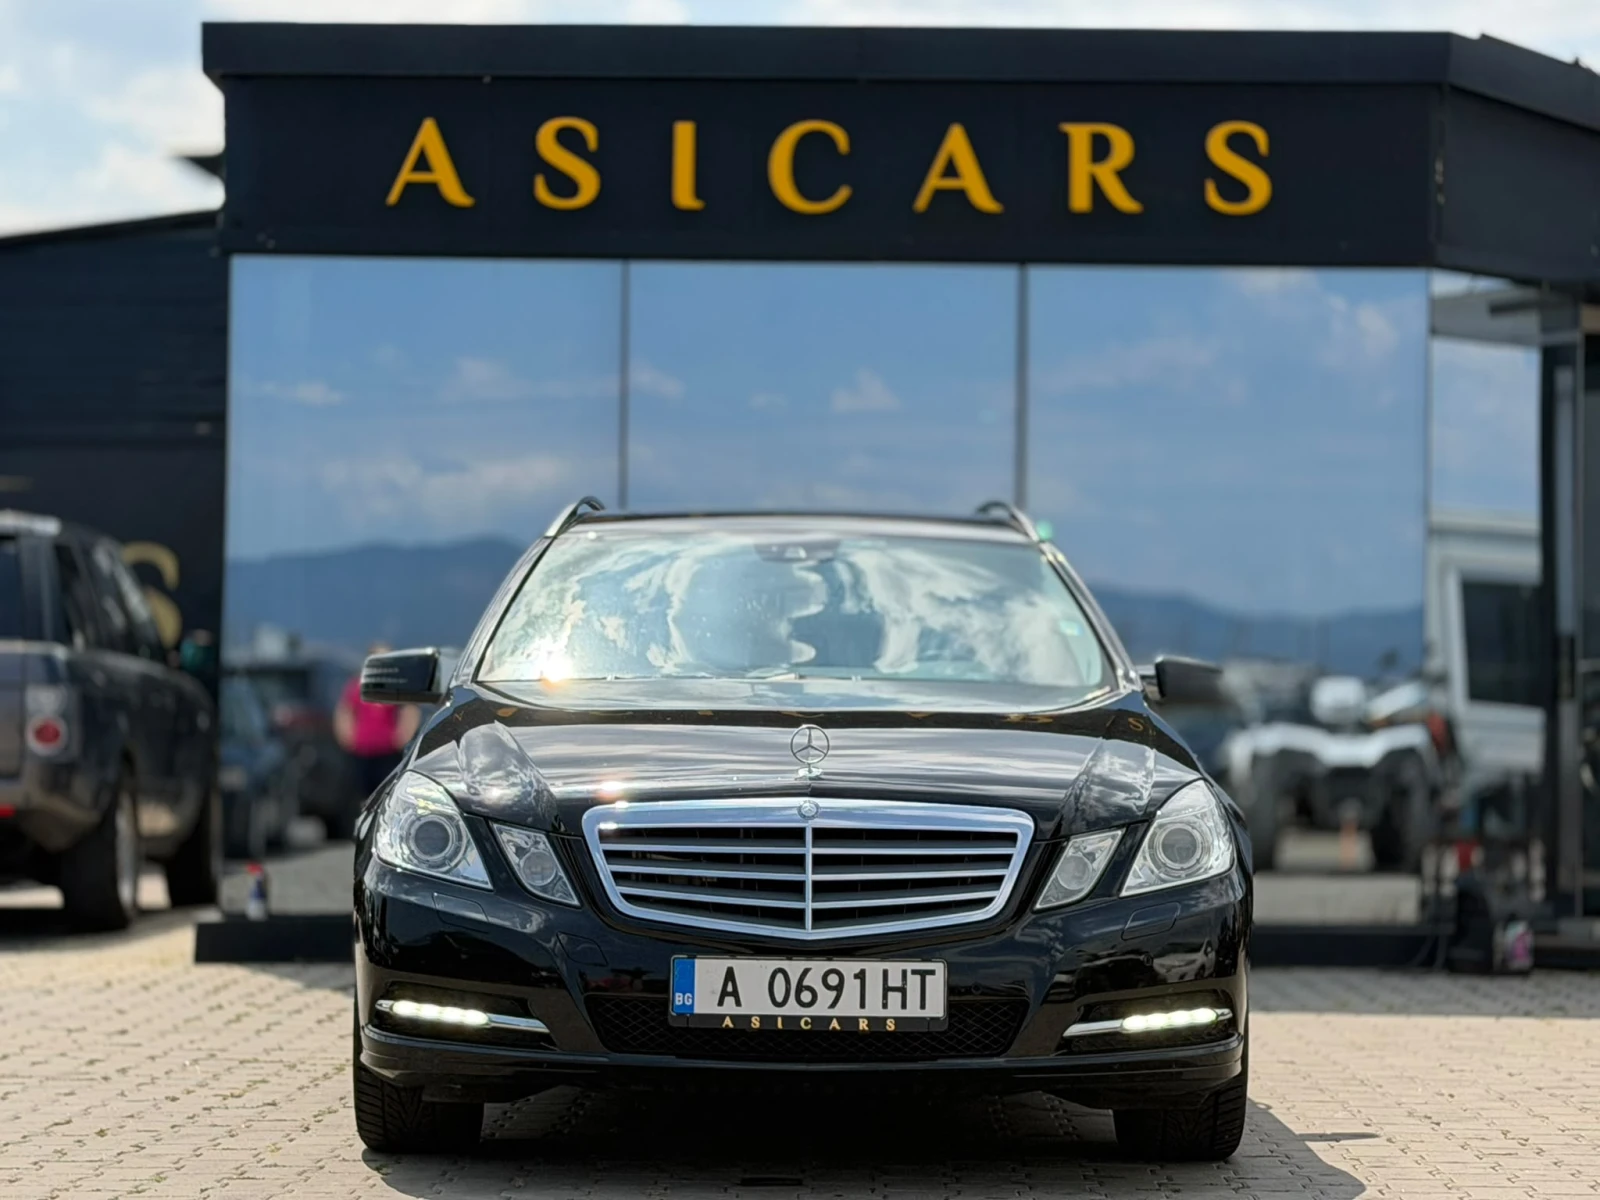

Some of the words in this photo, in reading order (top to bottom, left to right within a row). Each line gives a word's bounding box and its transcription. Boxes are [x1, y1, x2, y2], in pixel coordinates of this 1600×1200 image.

[386, 116, 1274, 215] ASICARS
[674, 992, 694, 1006] BG
[716, 966, 743, 1008] A
[721, 1015, 897, 1032] ASICARS
